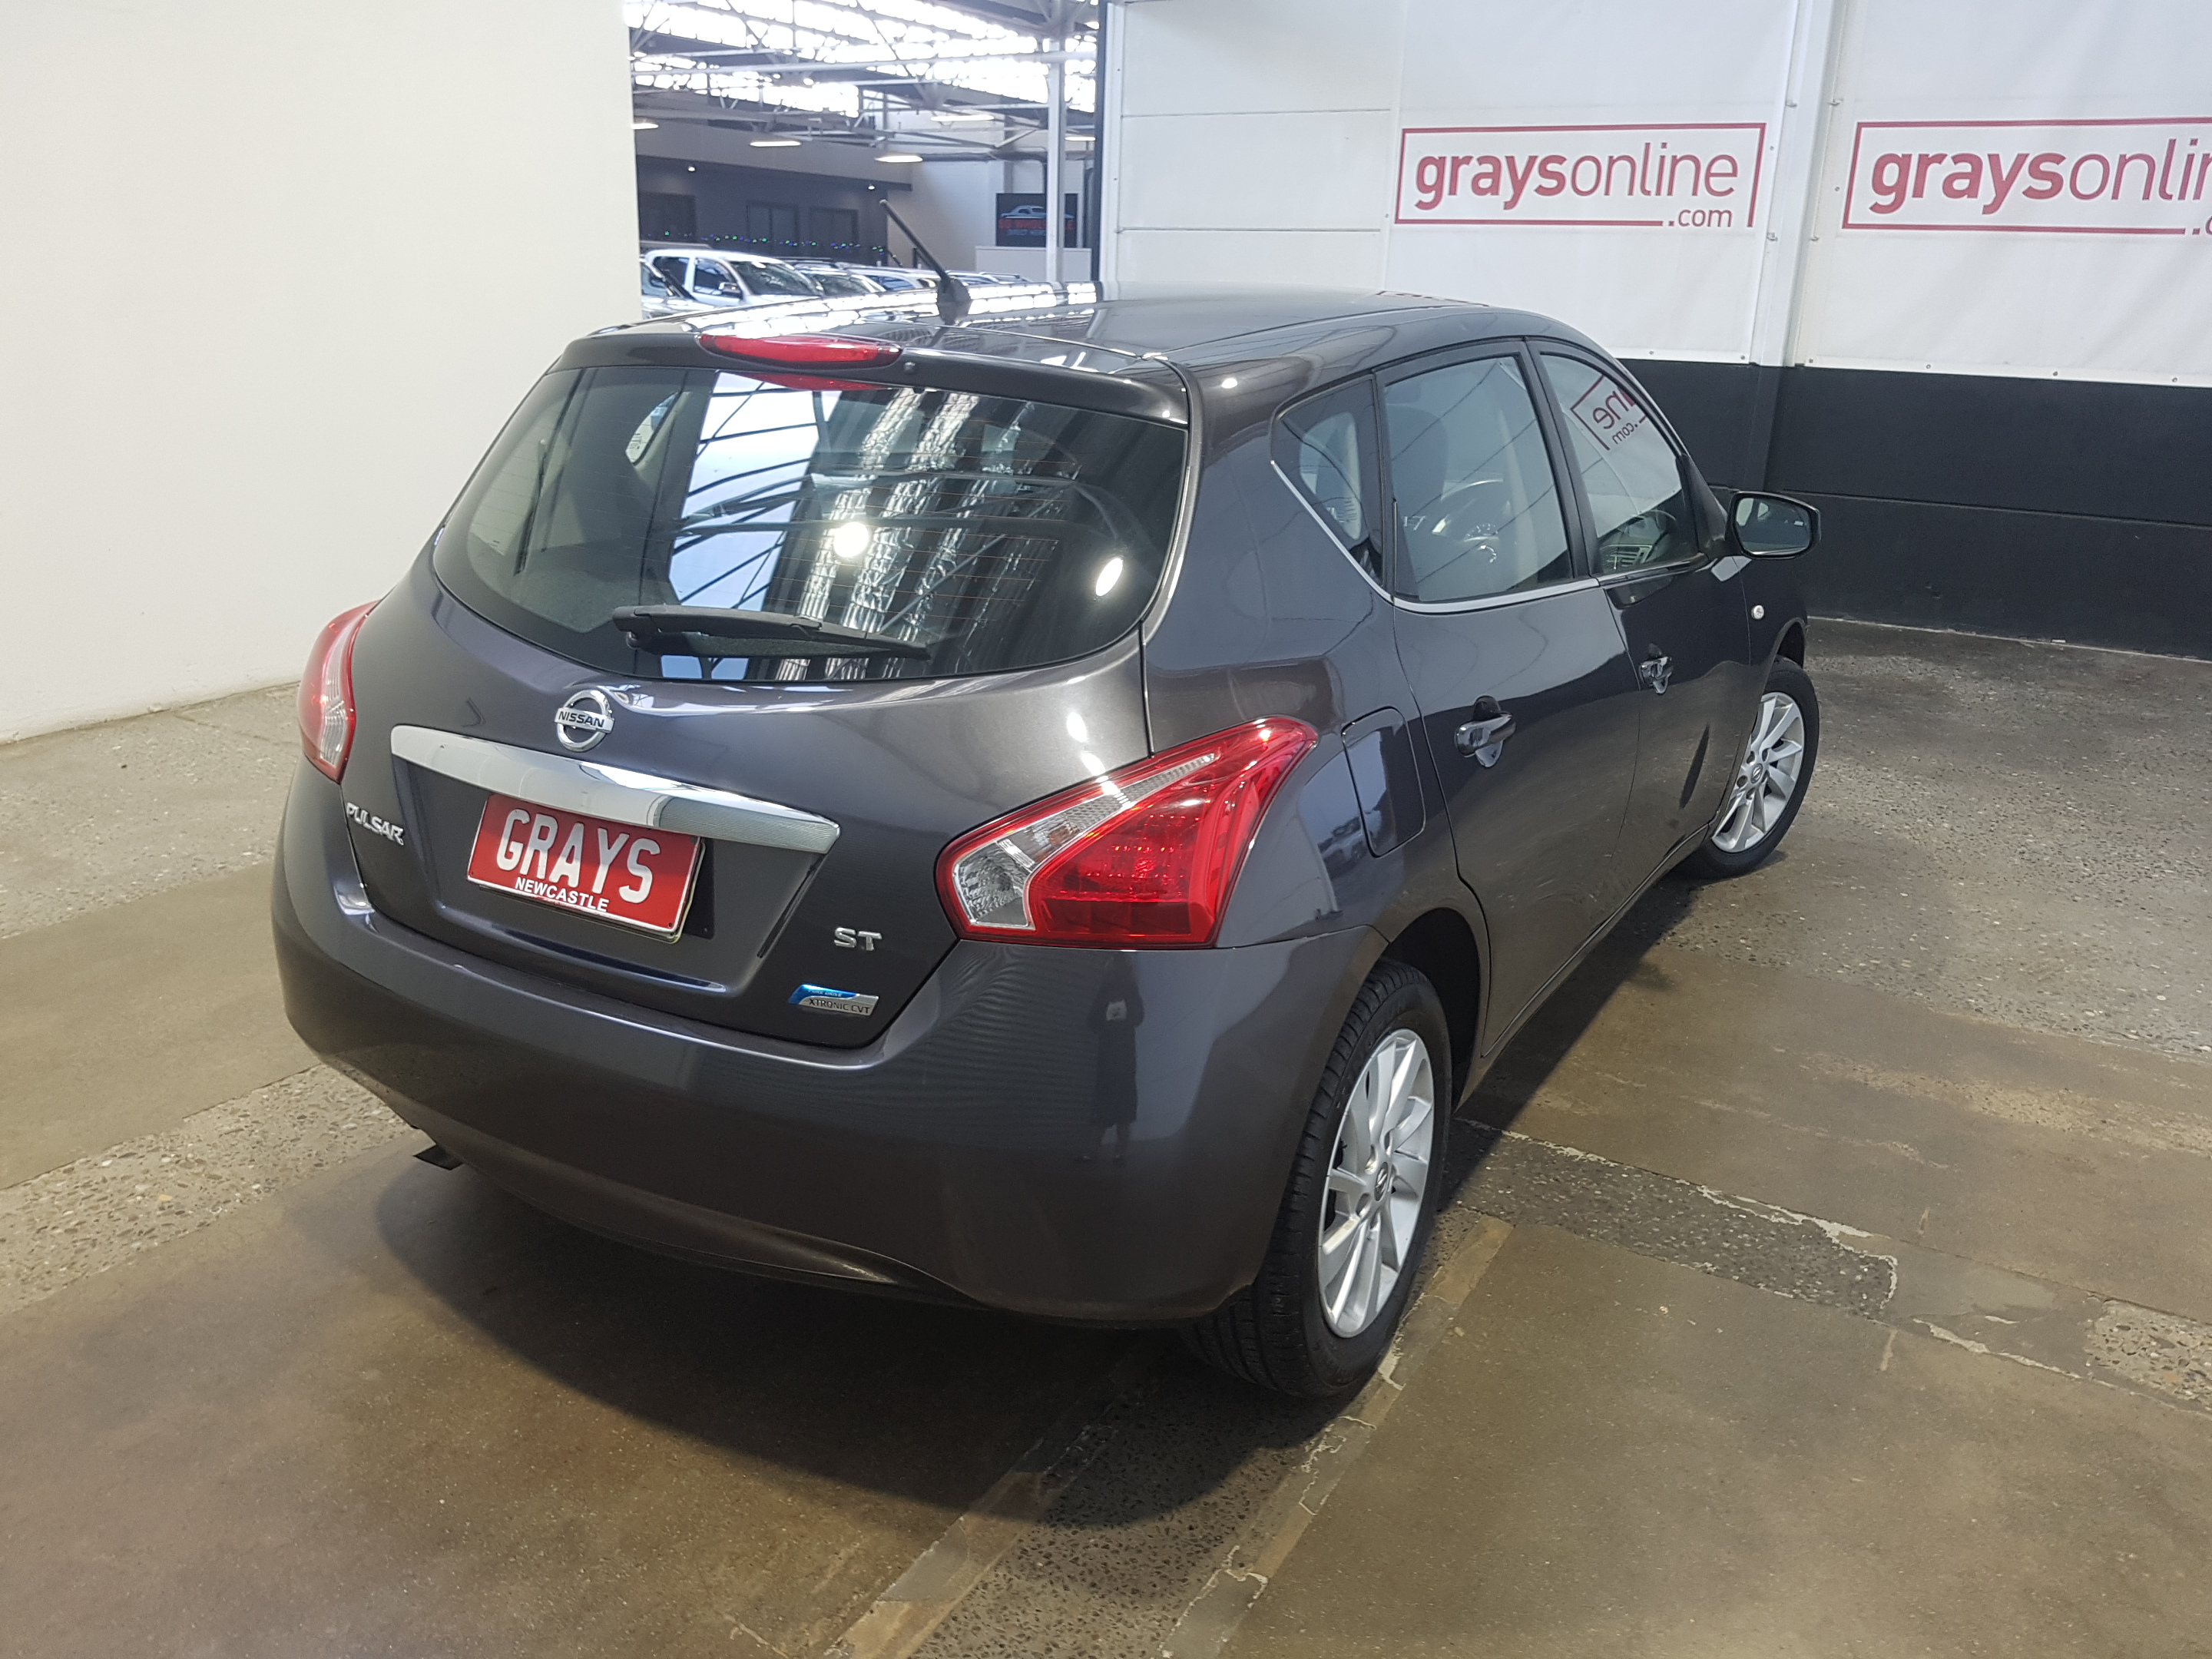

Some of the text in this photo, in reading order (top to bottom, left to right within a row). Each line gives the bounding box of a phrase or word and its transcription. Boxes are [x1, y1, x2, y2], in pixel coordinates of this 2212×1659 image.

[1414, 141, 1738, 210] graysonline
[1667, 208, 1733, 228] .com
[558, 710, 605, 728] NISSAN
[346, 802, 405, 846] PULSAR
[496, 808, 661, 904] GRAYS
[515, 876, 610, 913] NEWCASTLE
[833, 927, 882, 952] ST
[809, 998, 870, 1015] XTRONIC CVT
